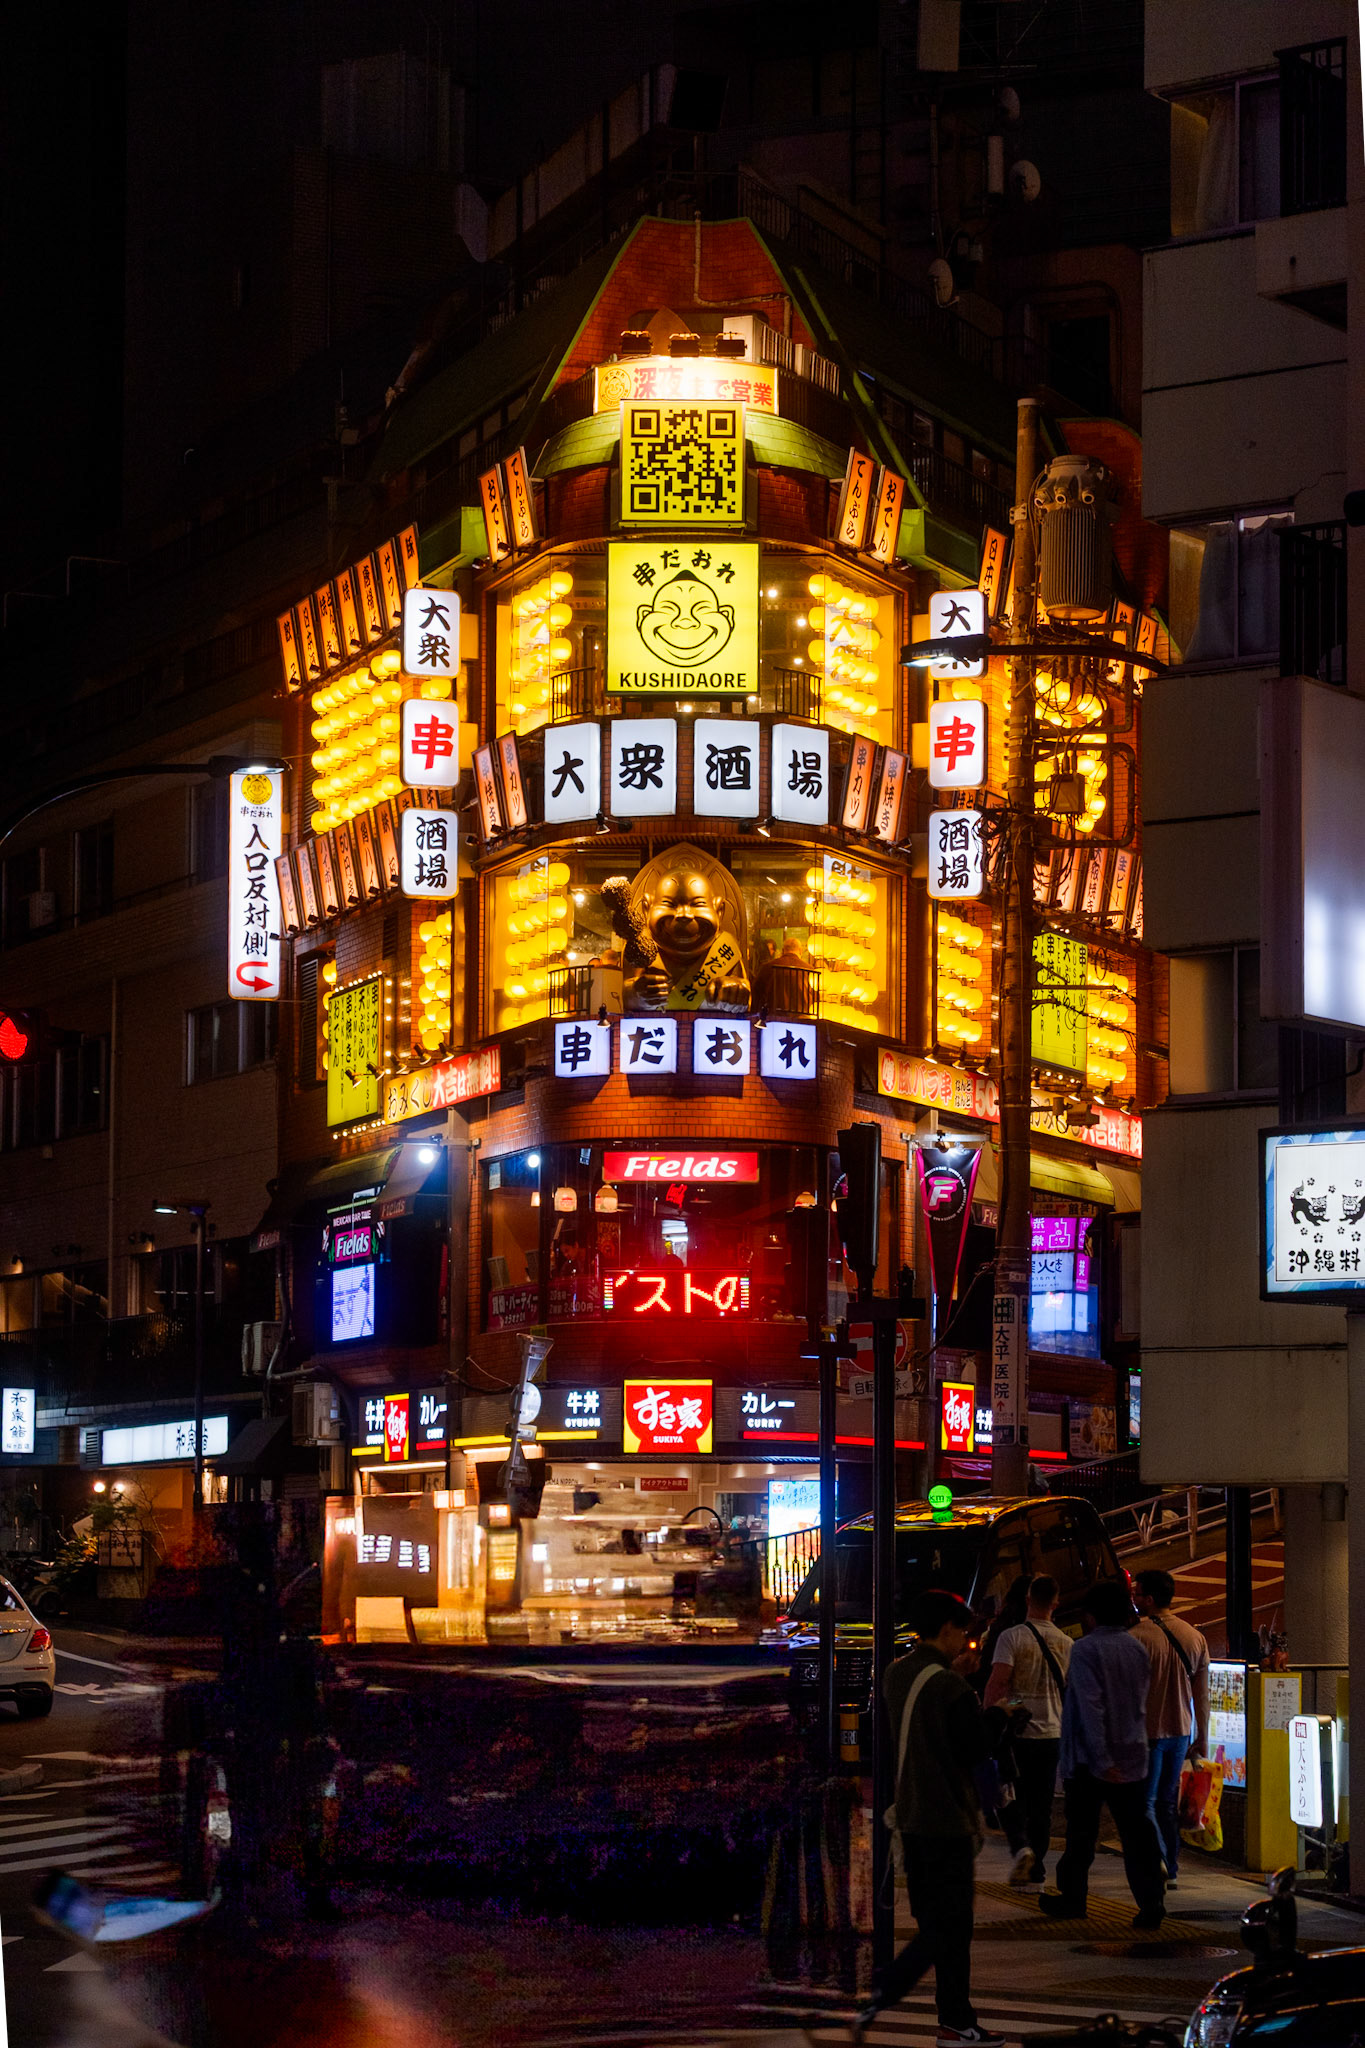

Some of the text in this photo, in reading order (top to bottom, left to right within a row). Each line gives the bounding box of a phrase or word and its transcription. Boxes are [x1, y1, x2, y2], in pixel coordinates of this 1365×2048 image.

[878, 479, 897, 553] おでん
[632, 549, 736, 588] 串だおれ
[418, 596, 451, 669] 大衆
[620, 672, 748, 688] KUSHIDAORE
[411, 714, 454, 770] 串
[934, 715, 976, 773] 串
[850, 745, 867, 819] 串カツ
[880, 759, 898, 832] 串焼き
[414, 816, 449, 889] 酒場
[937, 817, 971, 889] 酒場
[242, 823, 271, 957] 入口反対側
[680, 943, 735, 1002] 串だおれ
[560, 1024, 811, 1073] 串だおれ
[623, 1156, 738, 1178] Fields
[333, 1213, 351, 1227] MEXICAN
[336, 1231, 370, 1258] Fields
[1288, 1248, 1365, 1274] 沖縄料
[615, 1272, 739, 1314] ストの
[994, 1325, 1010, 1399] 大平医院
[9, 1391, 28, 1438] 和泉鮨
[365, 1398, 385, 1431] 牛丼
[419, 1394, 448, 1426] カレー
[566, 1390, 600, 1414] 牛丼
[632, 1386, 703, 1435] すき家
[741, 1391, 796, 1415] カレー
[746, 1417, 783, 1429] CURRY
[944, 1389, 971, 1434] すき家
[652, 1435, 684, 1444] SUKIYA
